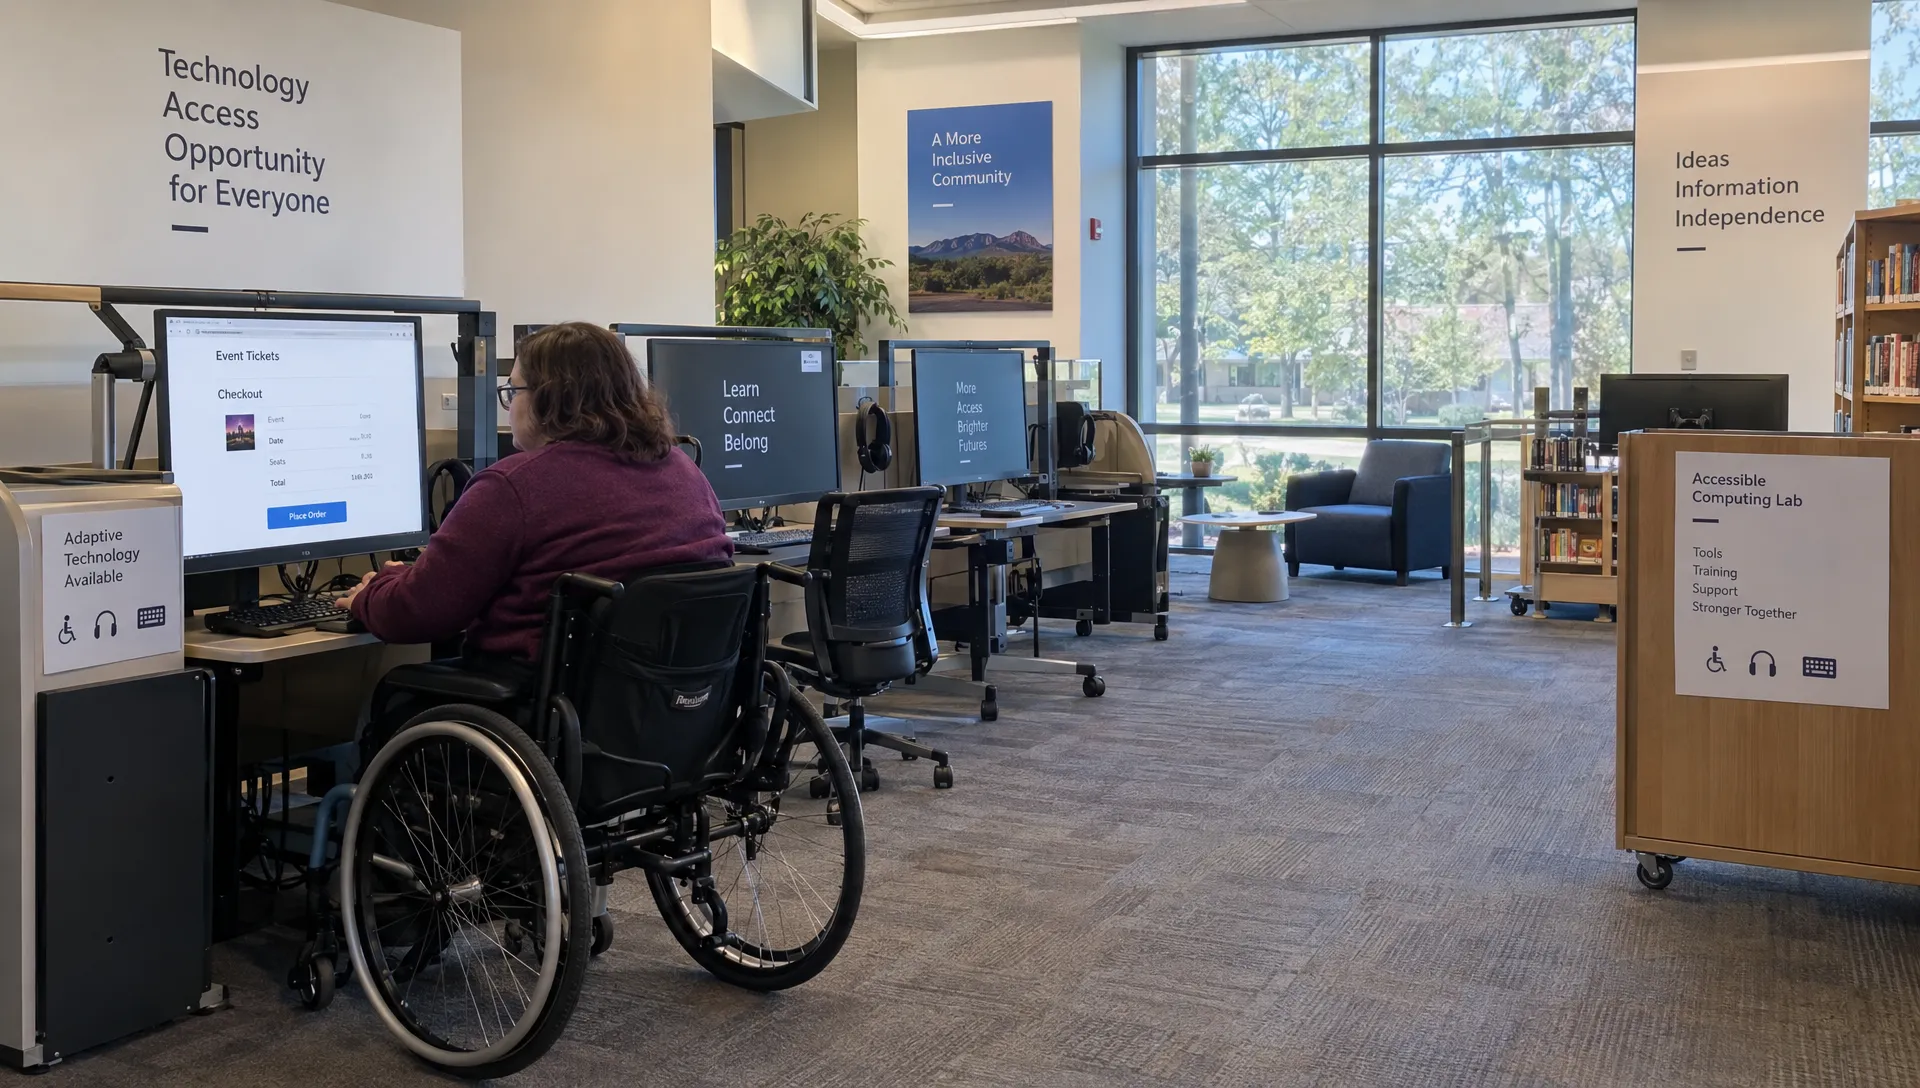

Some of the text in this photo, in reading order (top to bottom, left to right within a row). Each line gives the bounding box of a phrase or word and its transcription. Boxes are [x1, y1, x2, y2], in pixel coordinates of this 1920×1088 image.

[158, 48, 309, 104] Technology
[163, 92, 259, 130] Access
[931, 131, 982, 147] A More
[164, 133, 326, 181] Opportunity
[932, 150, 992, 167] Inclusive
[1676, 150, 1730, 169] Ideas
[932, 169, 1012, 187] Community
[169, 174, 330, 216] for Everyone
[1676, 176, 1799, 199] Information
[1675, 205, 1825, 231] Independence
[215, 350, 280, 361] Event Tickets
[217, 388, 263, 400] Checkout
[723, 379, 760, 398] Learn
[956, 381, 977, 395] More
[723, 406, 776, 425] Connect
[956, 400, 983, 414] Access
[267, 415, 285, 424] Event
[957, 419, 989, 436] Brighter
[268, 437, 284, 445] Date
[724, 432, 769, 454] Belong
[958, 438, 988, 453] Futures
[269, 458, 287, 466] Seats
[270, 479, 286, 487] Total
[1692, 472, 1767, 487] Accessible
[1692, 490, 1803, 508] Computing Lab
[288, 510, 327, 521] Place Order
[64, 529, 123, 546] Adaptive
[64, 548, 140, 566] Technology
[1692, 546, 1723, 559] Tools
[65, 569, 123, 587] Available
[1692, 564, 1738, 581] Training
[1693, 583, 1738, 598] Support
[1692, 600, 1798, 620] Stronger Together
